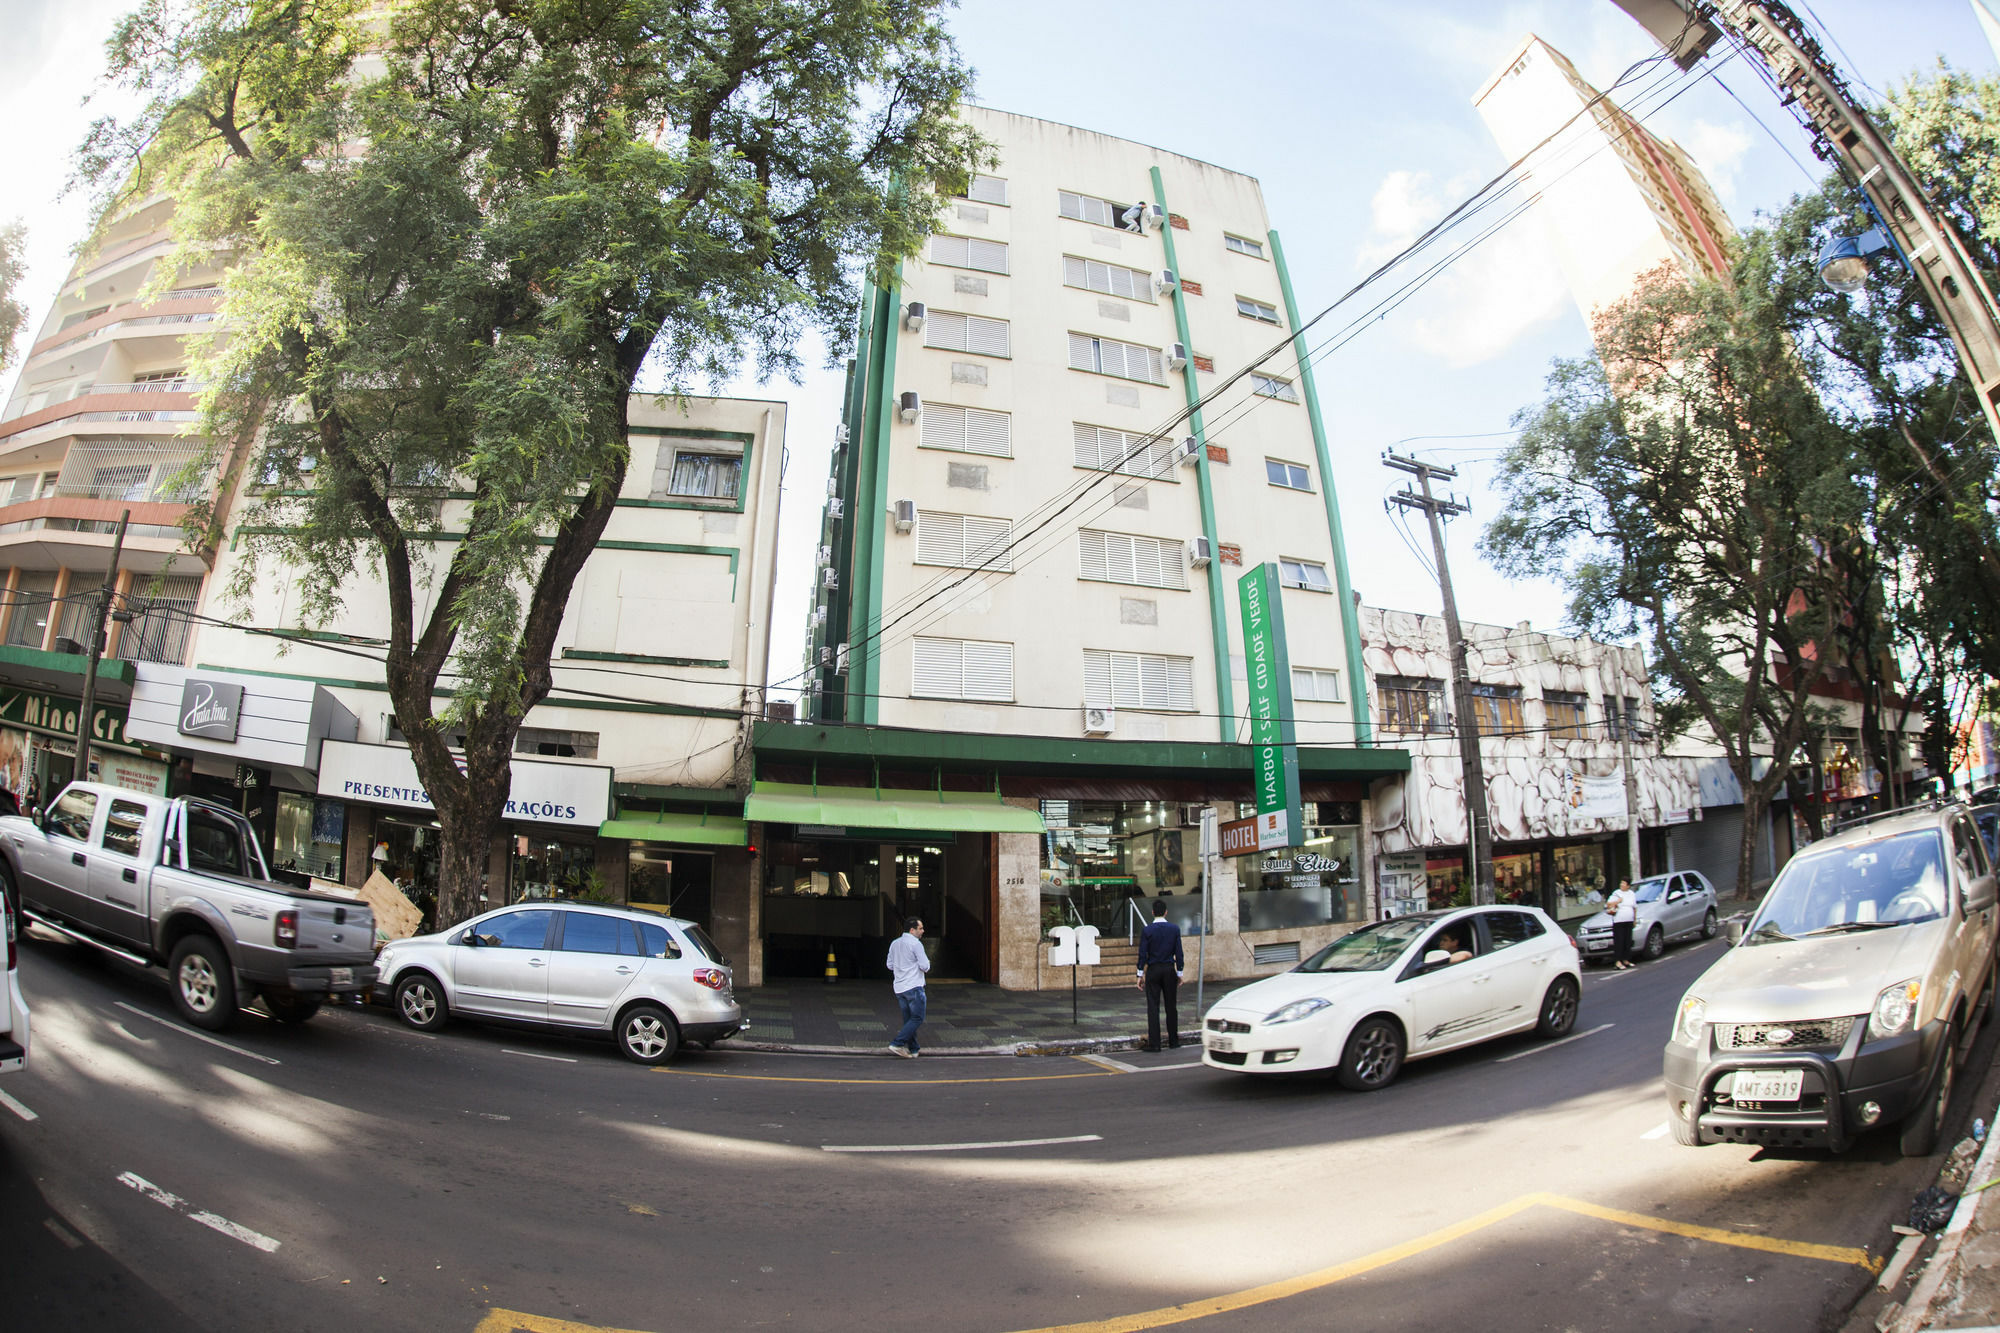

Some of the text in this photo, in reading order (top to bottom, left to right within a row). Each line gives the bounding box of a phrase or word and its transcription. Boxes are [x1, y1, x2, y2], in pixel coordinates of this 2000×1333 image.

[1247, 577, 1277, 806] HARBOR SELF CIDADE VERDE
[24, 695, 77, 733] Mina
[344, 780, 429, 803] PRESENTES
[1223, 825, 1256, 851] HOTEL
[1261, 854, 1340, 872] EQUIPE Elite
